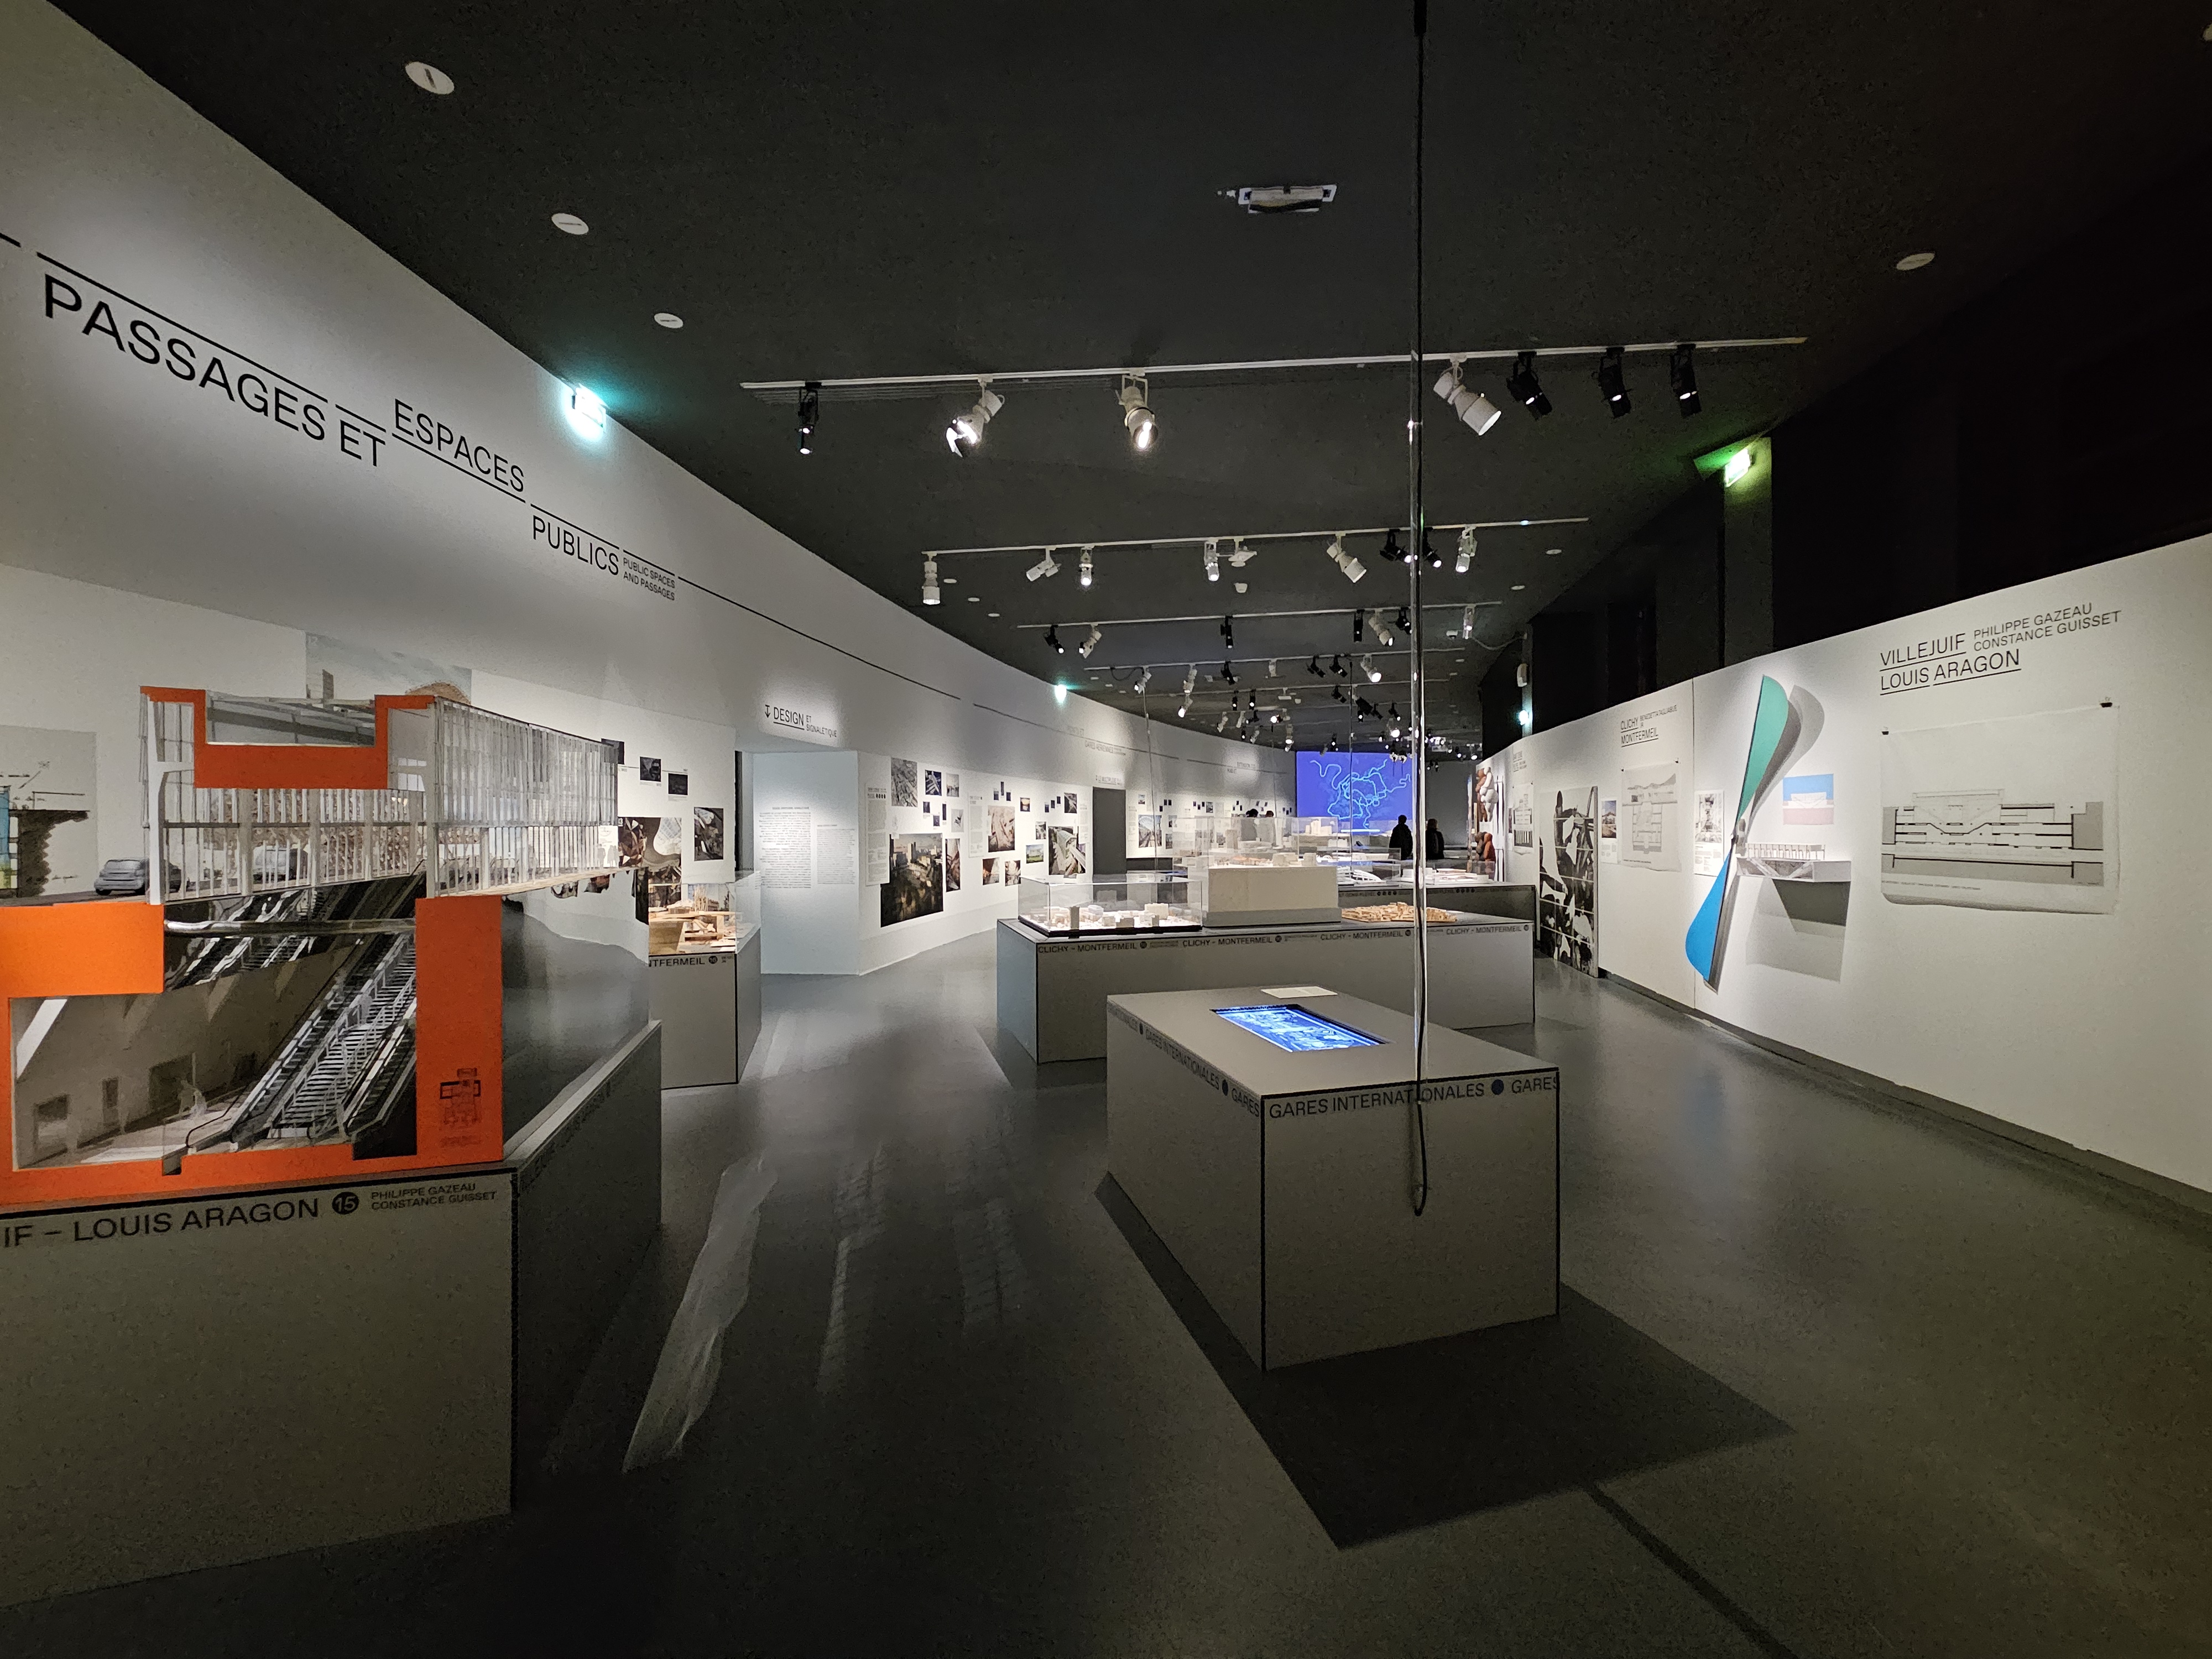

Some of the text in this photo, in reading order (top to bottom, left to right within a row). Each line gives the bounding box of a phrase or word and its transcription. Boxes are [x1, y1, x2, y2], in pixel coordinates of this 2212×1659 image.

[45, 273, 386, 467] PASSAGES ET
[394, 398, 524, 492] ESPACES
[533, 514, 619, 576] PUBLICS
[623, 557, 675, 589] PUBLIC SPACES
[623, 571, 675, 601] AND PASSAGES
[1973, 602, 2093, 640] PHILIPPE GAZEAU
[1973, 610, 2122, 652] CONSTANCE GUISSET
[1880, 633, 1966, 666] VILLEJUIF
[1881, 648, 2020, 691] LOUIS ARAGON
[773, 707, 804, 726] DESIGN
[1620, 716, 1639, 730] CLICHY
[1621, 727, 1658, 744] MONTFERMEIL
[1077, 943, 1138, 952] MONTFERMEIL
[1182, 940, 1211, 948] CLICHY
[1218, 936, 1273, 945] MONTFERMEIL
[1353, 931, 1403, 940] MONTFERMEIL
[1232, 1088, 1260, 1117] GARES
[1269, 1099, 1328, 1119] GARES
[1332, 1083, 1485, 1112] INTERNATONALES
[371, 1182, 476, 1201] PHILIPPE GAZEAU
[371, 1191, 498, 1211] CONSTANCE GUISSET
[4, 1224, 33, 1248] IF
[74, 1212, 171, 1241] LOUIS
[180, 1198, 319, 1231] ARAGON
[334, 1194, 357, 1213] 15
